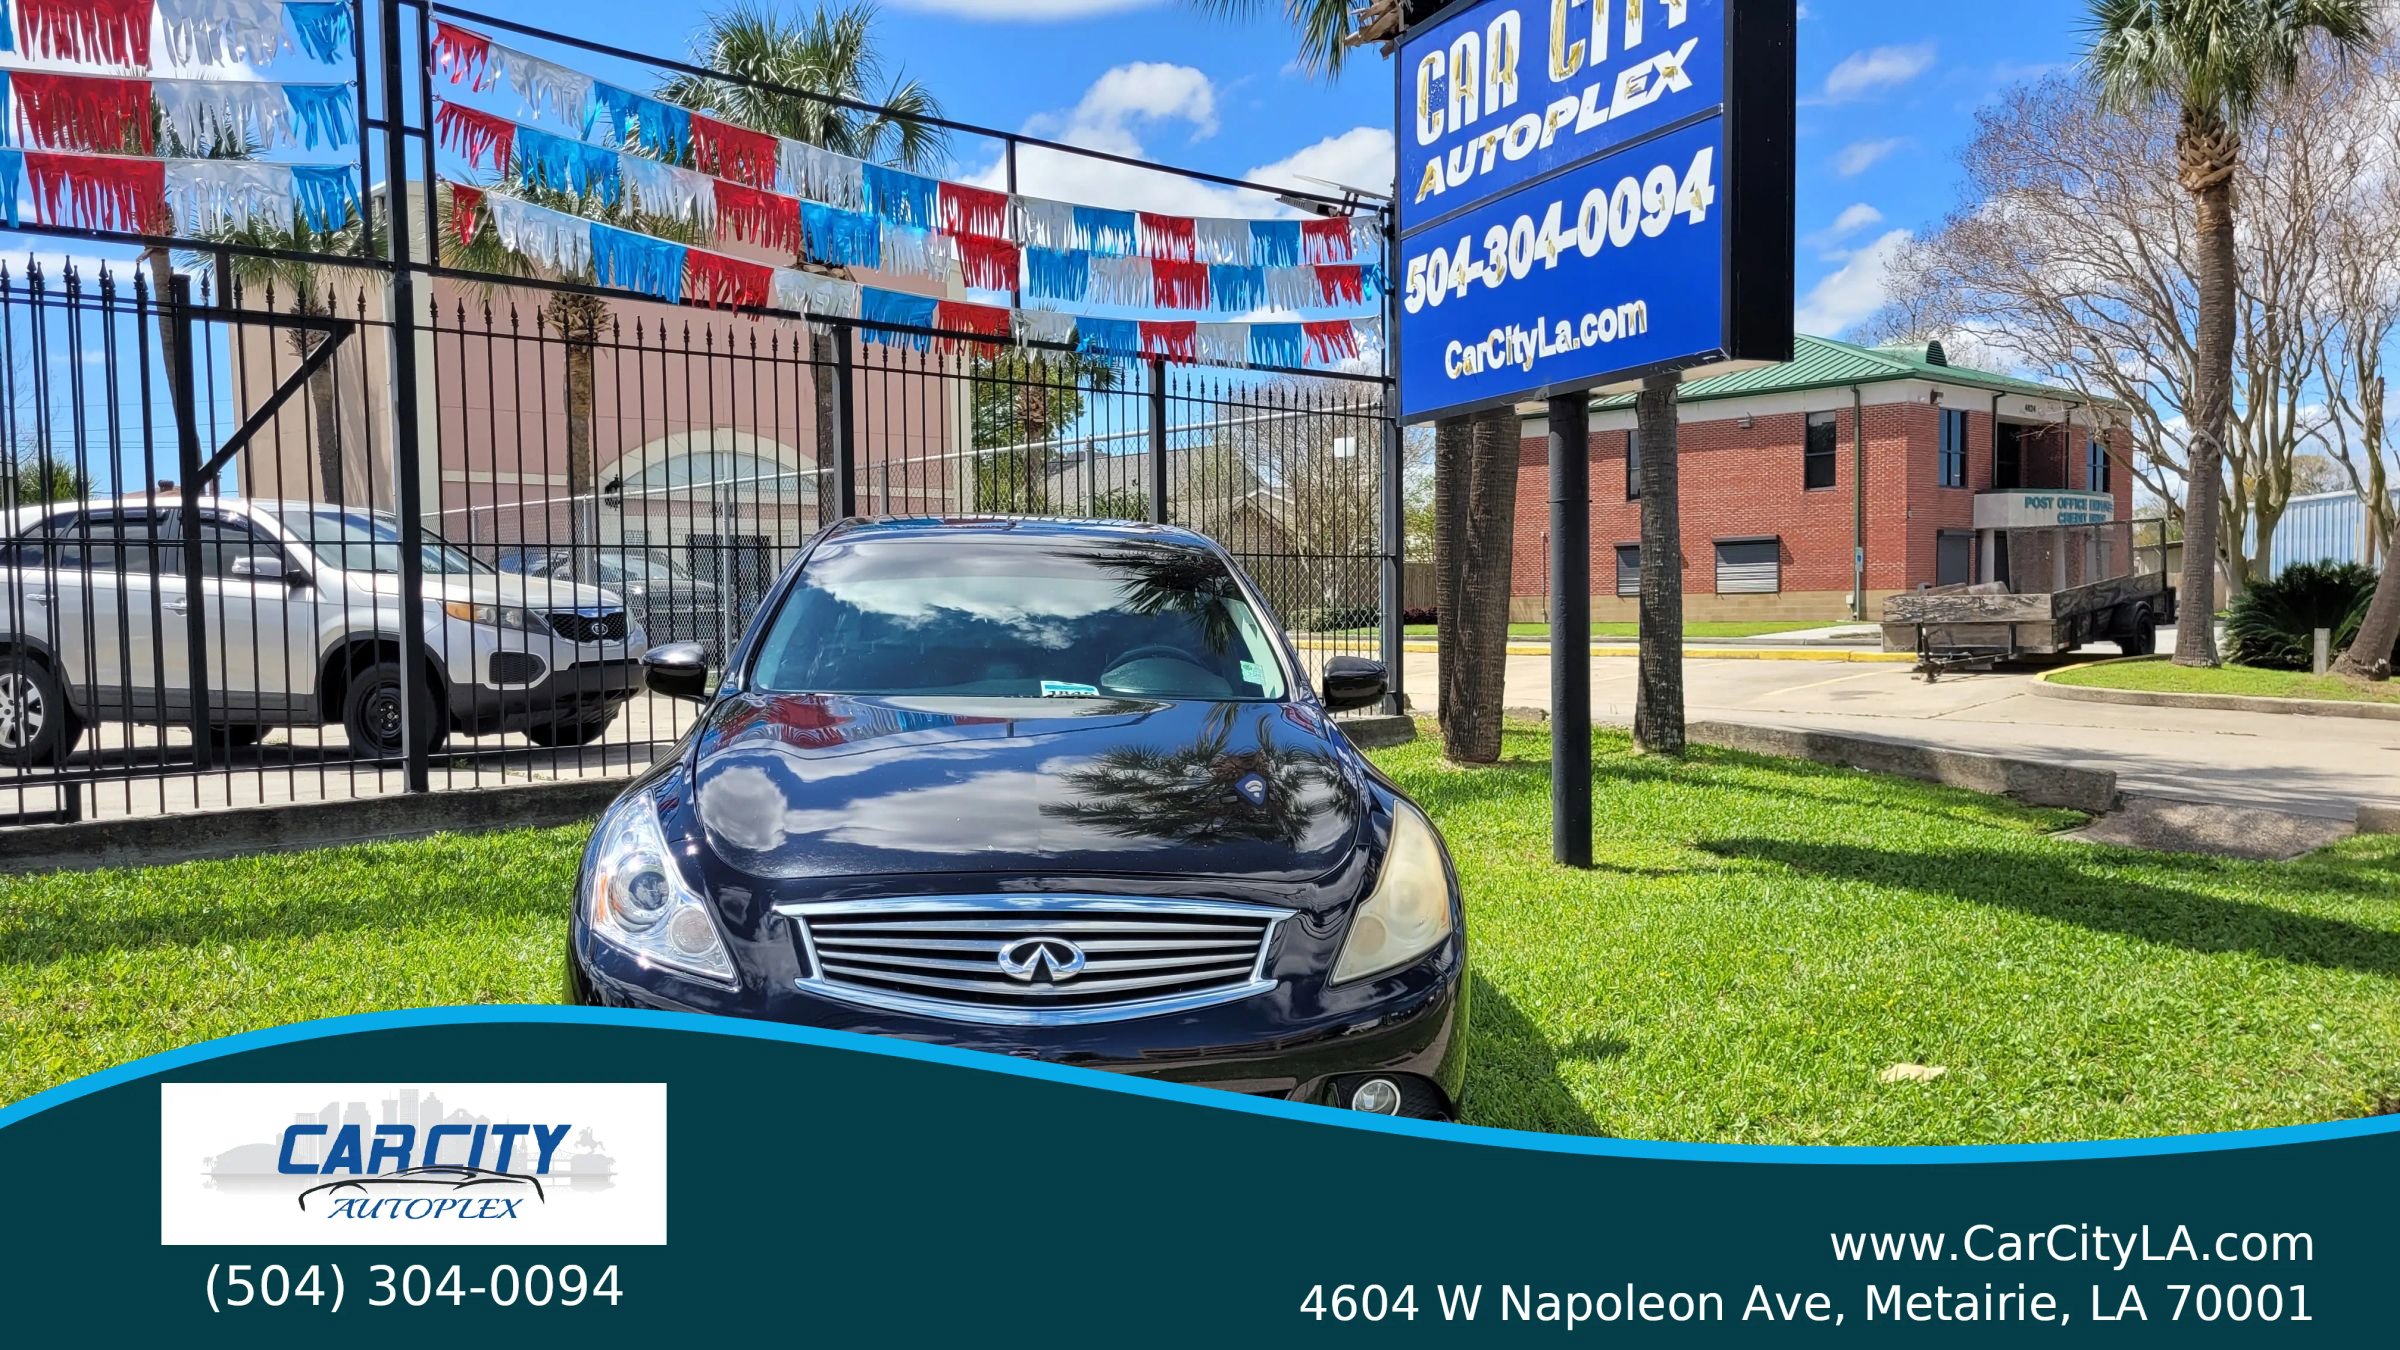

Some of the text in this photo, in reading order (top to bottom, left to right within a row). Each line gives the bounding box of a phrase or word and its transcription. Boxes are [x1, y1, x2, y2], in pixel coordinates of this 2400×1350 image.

[1415, 37, 1699, 205] AUTOPLEX
[1416, 0, 1688, 146] CAR CI
[1404, 146, 1715, 314] 504-304-0094
[2024, 496, 2054, 510] POST
